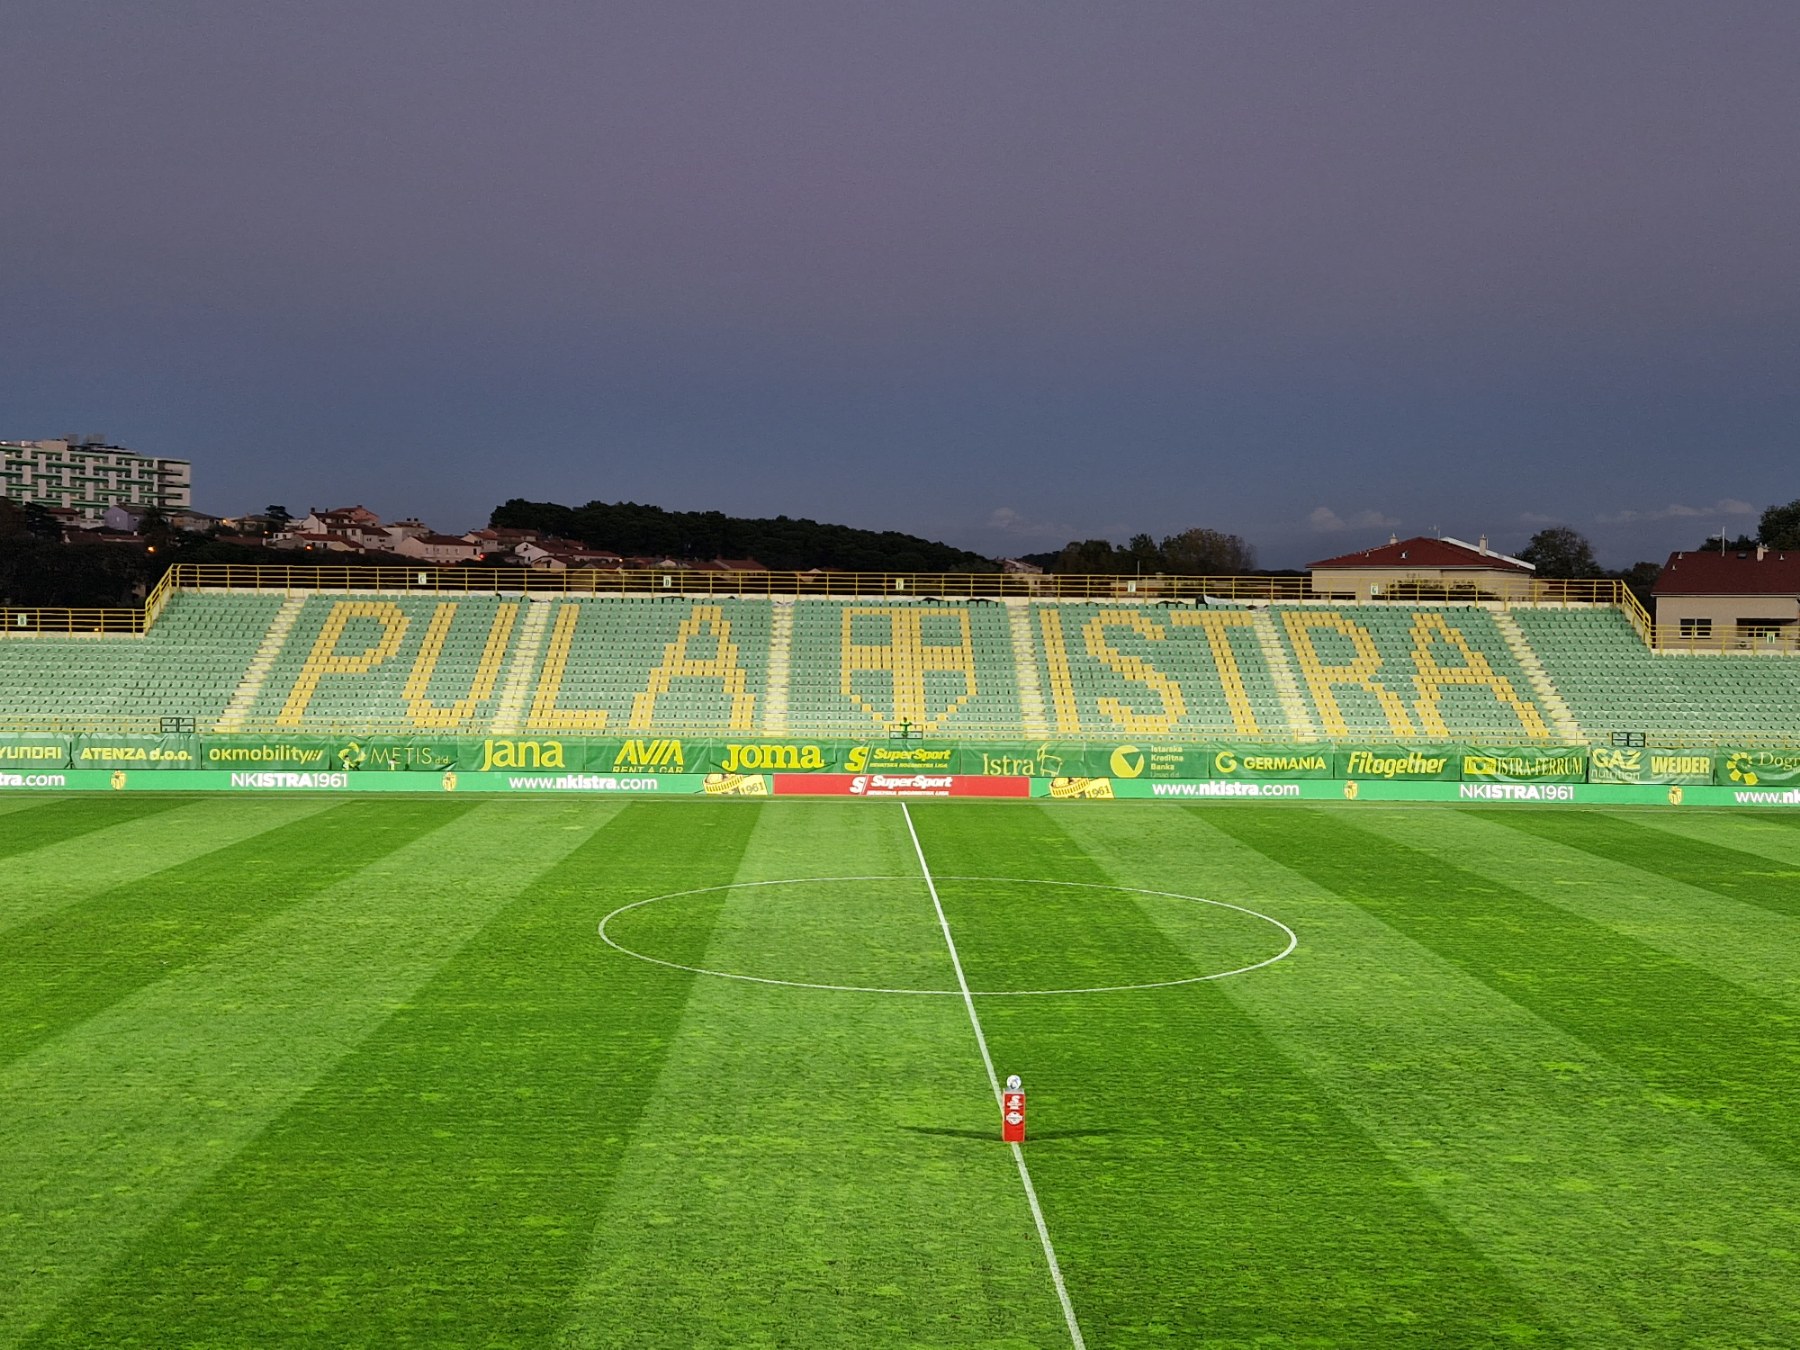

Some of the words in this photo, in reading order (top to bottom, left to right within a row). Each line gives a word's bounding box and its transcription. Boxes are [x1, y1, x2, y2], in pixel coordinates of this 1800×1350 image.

[277, 602, 755, 728] PULA
[1039, 608, 1550, 737] ISTRA
[80, 747, 147, 760] ATENZA
[150, 748, 193, 760] d.o.o.
[370, 747, 432, 764] METIS
[613, 740, 684, 765] AVIA
[873, 747, 952, 762] SuperSport
[1592, 749, 1641, 770] GAZ
[983, 753, 1036, 776] Istra
[1243, 756, 1327, 770] GERMANIA
[1347, 751, 1447, 779] Fitogether
[1650, 756, 1711, 774] WEIDER
[508, 775, 658, 790] www.nkistra.com
[871, 775, 953, 790] SuperSport
[1152, 781, 1300, 796] www.nkistra.com
